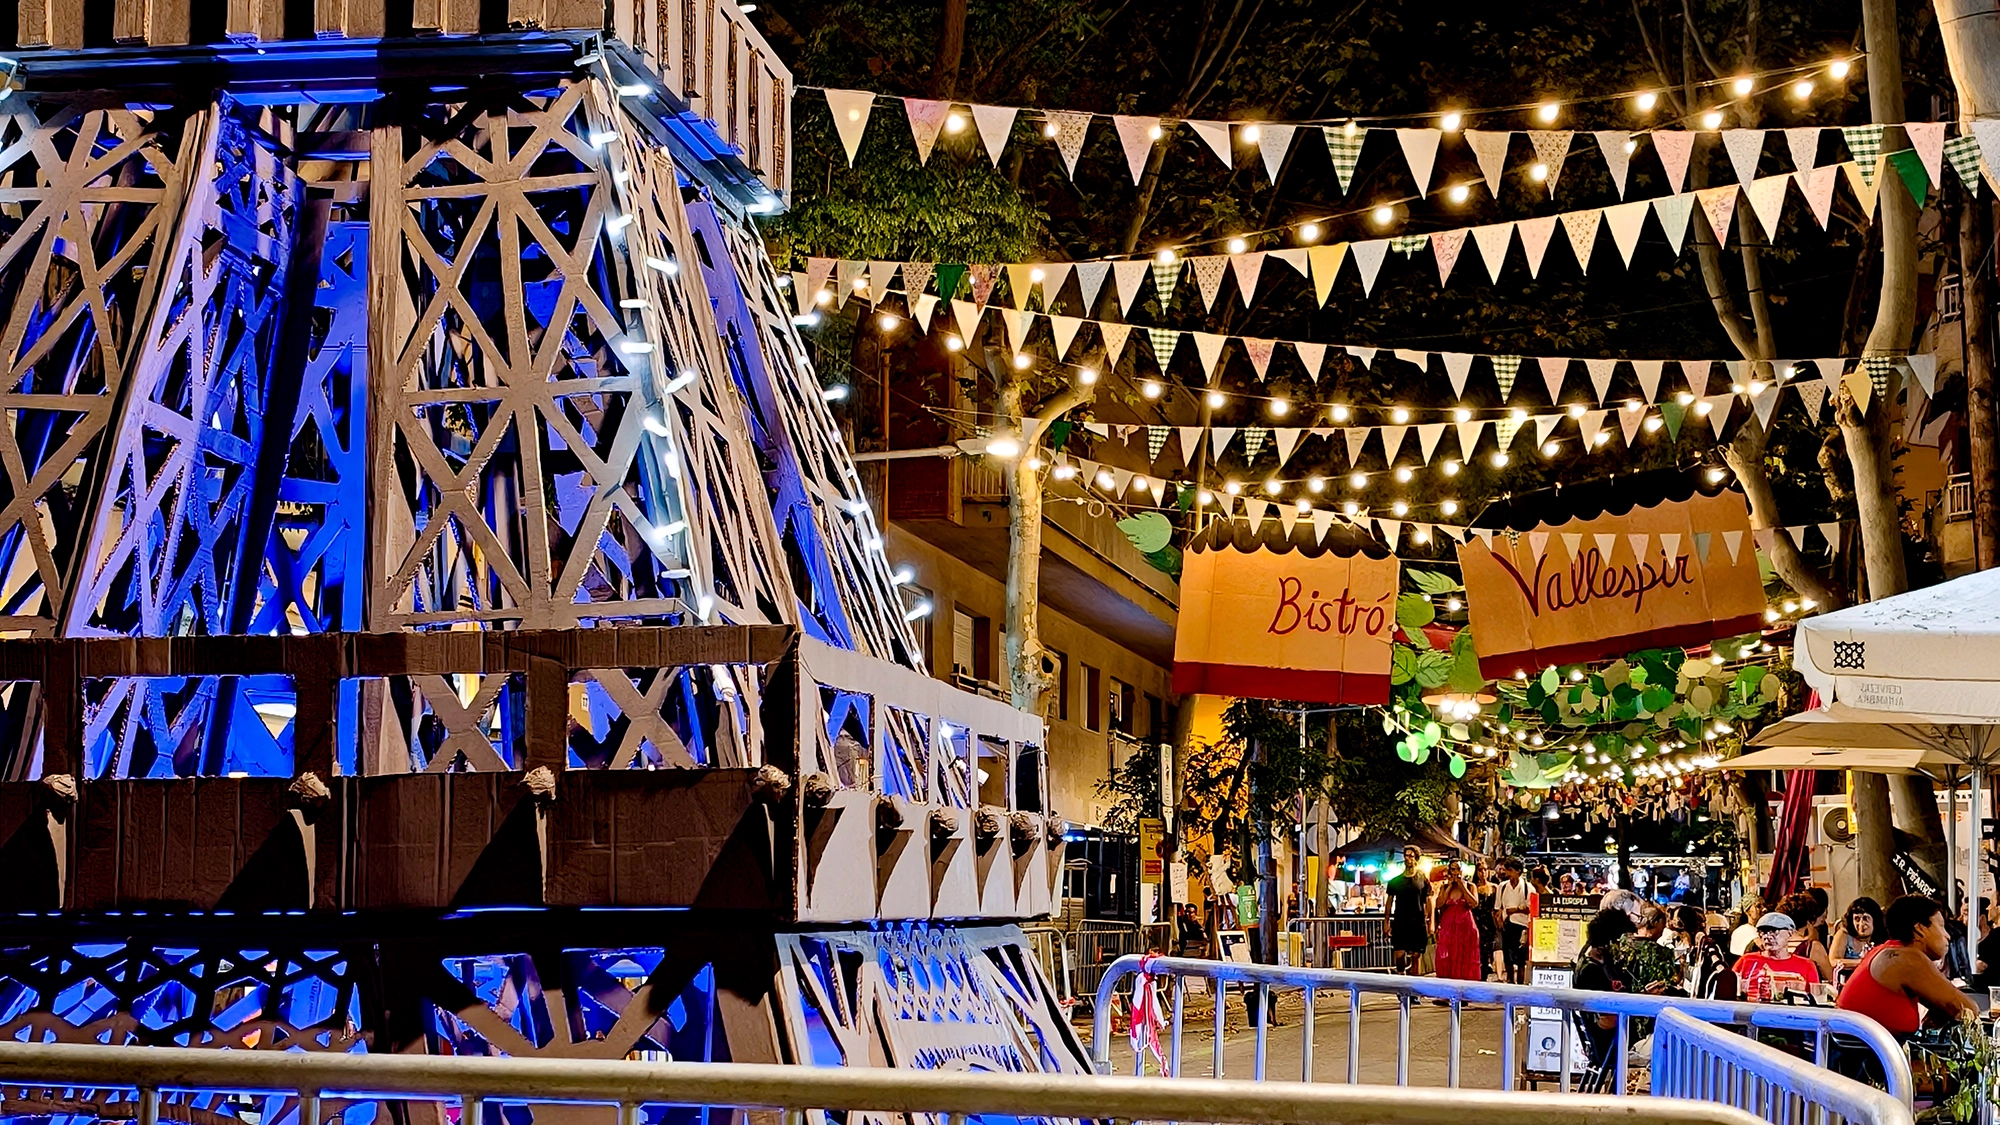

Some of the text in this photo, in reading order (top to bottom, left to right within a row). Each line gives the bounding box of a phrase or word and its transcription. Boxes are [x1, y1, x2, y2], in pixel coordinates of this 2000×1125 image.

[1267, 576, 1391, 635] Bistró
[1552, 897, 1561, 905] LA
[1538, 973, 1564, 981] TINTO
